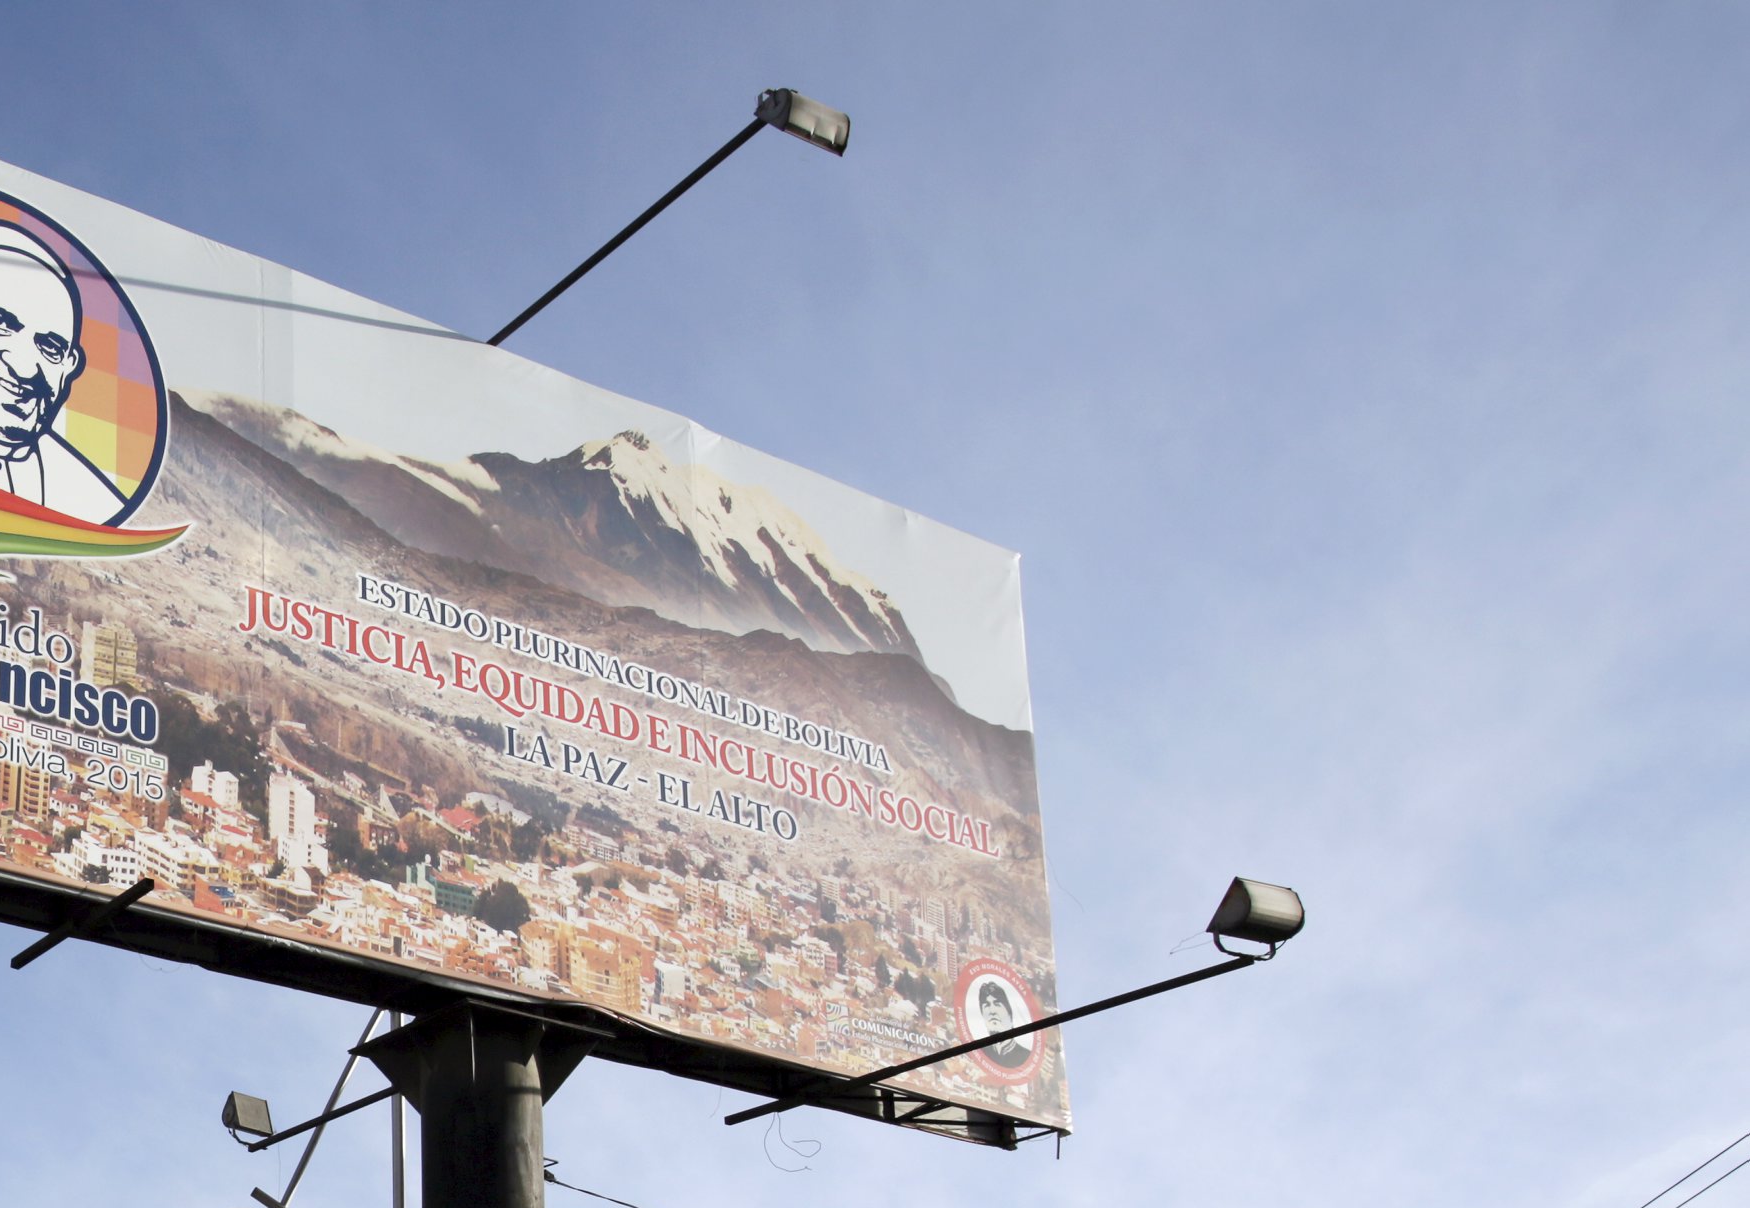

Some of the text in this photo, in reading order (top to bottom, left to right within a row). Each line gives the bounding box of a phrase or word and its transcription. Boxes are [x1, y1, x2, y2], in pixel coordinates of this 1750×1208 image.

[239, 585, 999, 857] JUSTICIA, EQUIDAD E INCLUSIÓN SOCIAL
[358, 575, 892, 772] ESTADO PLURINACIONAL DE BOLIVIA
[86, 759, 164, 799] 2015
[505, 725, 554, 769] LA
[561, 742, 629, 791] PAZ
[657, 772, 700, 812] EL
[707, 790, 797, 840] ALTO
[851, 1017, 936, 1048] COMUNICACIÓN
